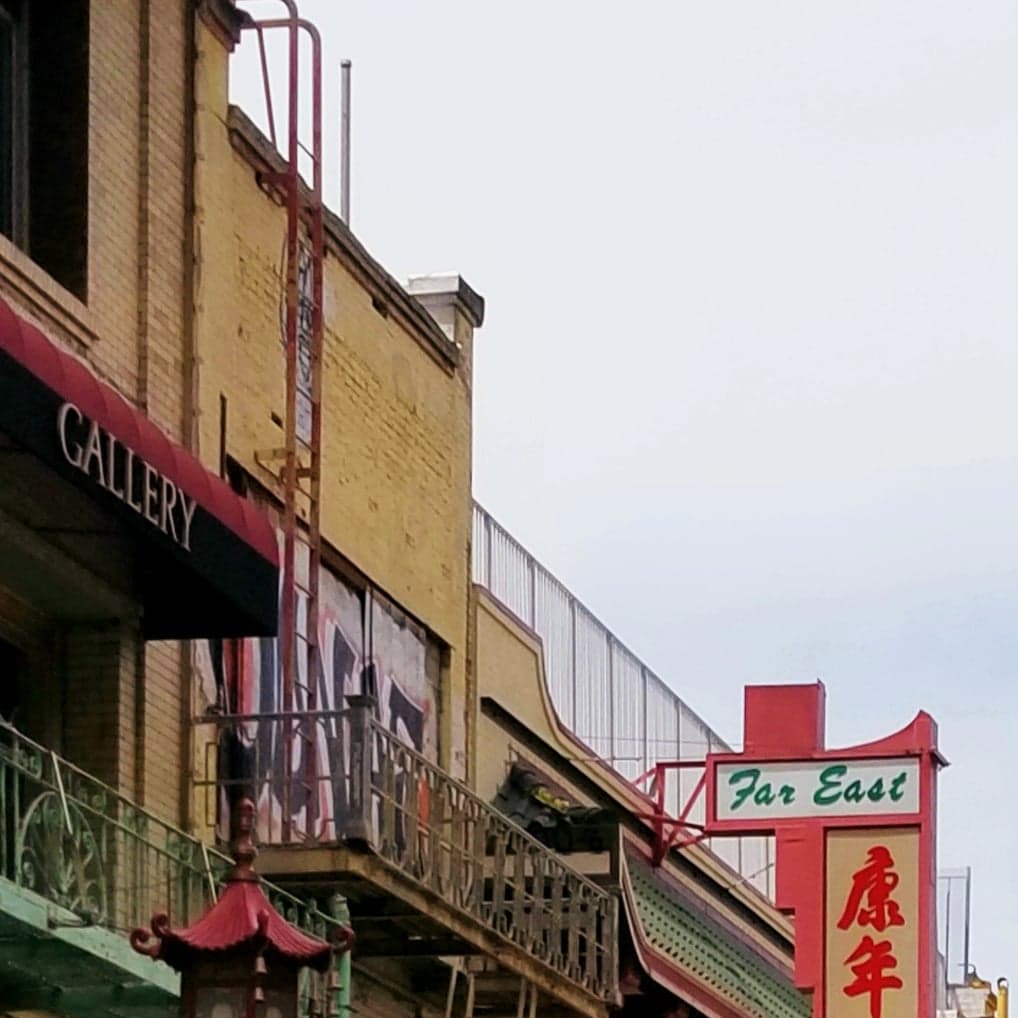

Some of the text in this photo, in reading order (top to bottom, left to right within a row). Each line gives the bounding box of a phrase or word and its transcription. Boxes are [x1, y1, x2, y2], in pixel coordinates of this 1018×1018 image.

[57, 402, 197, 552] GALLERY
[728, 764, 908, 811] Far East
